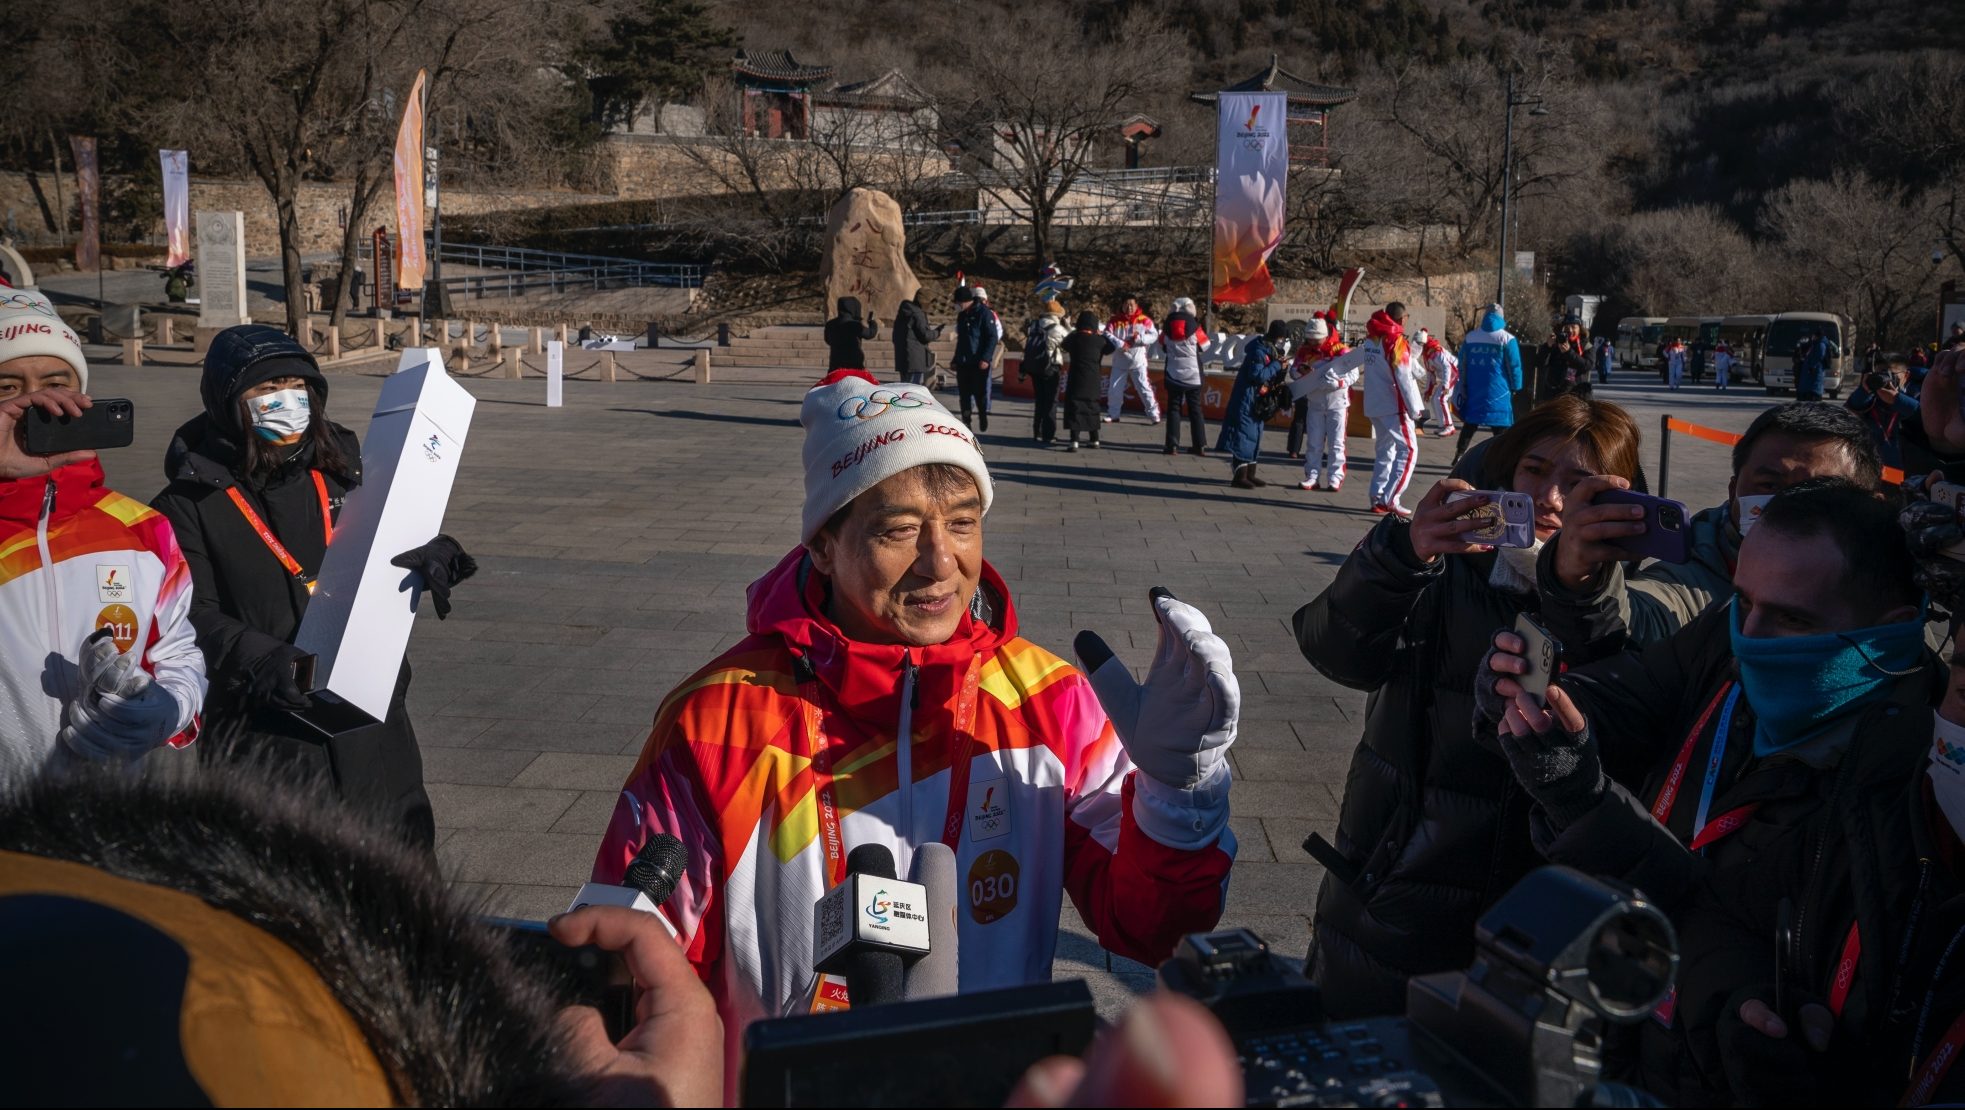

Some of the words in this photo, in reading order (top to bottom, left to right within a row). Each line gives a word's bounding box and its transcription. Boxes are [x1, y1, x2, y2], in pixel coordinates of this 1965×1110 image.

[849, 218, 883, 303] 八达岭
[1204, 387, 1222, 408] 向
[831, 428, 905, 480] BEIJING
[822, 791, 834, 819] 2022
[1656, 785, 1674, 817] BEIJING
[1669, 762, 1683, 785] 2022
[826, 822, 840, 860] BEIJING
[972, 872, 1014, 907] 030
[869, 923, 891, 931] YANQING
[1931, 1041, 1955, 1074] 2022
